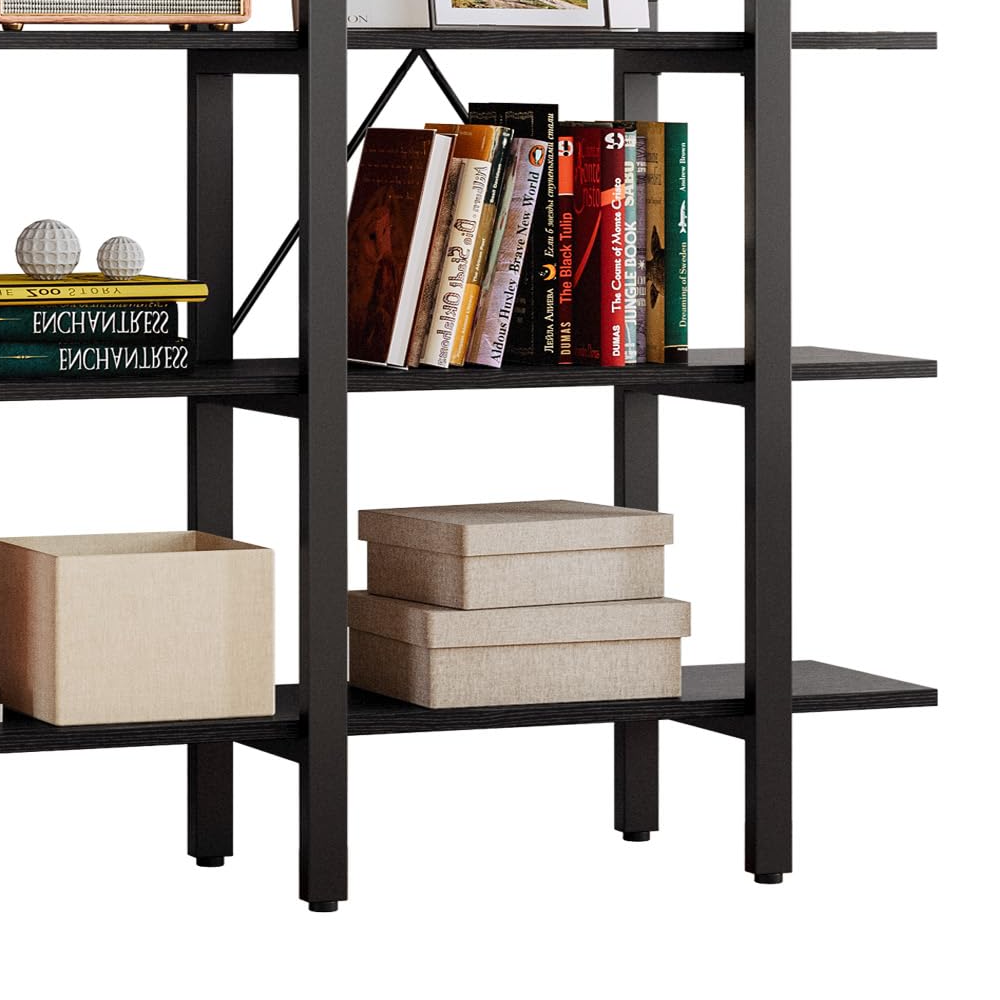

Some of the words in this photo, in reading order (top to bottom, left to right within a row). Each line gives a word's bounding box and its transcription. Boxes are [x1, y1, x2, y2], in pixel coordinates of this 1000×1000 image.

[546, 113, 556, 140] стали
[678, 142, 688, 163] Brown
[545, 142, 556, 197] ступеньками
[678, 164, 688, 192] Andrew
[521, 171, 540, 207] World
[611, 177, 622, 210] Cristo
[516, 209, 531, 237] New
[545, 199, 556, 227] звезды
[559, 212, 574, 242] Tulip
[611, 212, 622, 245] Monte
[509, 237, 526, 273] Brave
[543, 235, 555, 258] Если
[611, 247, 623, 257] of
[625, 221, 637, 267] BOOK
[678, 242, 688, 274] Sweden
[559, 244, 573, 277] Black
[611, 258, 622, 290] Count
[559, 281, 573, 304] The
[678, 275, 688, 286] of
[499, 279, 518, 321] Huxley
[611, 291, 622, 313] The
[625, 270, 637, 325] JUNGLE
[678, 288, 688, 328] Dreaming
[490, 322, 508, 363] Aldous
[560, 321, 571, 355] DUMAS
[612, 325, 621, 357] DUMAS
